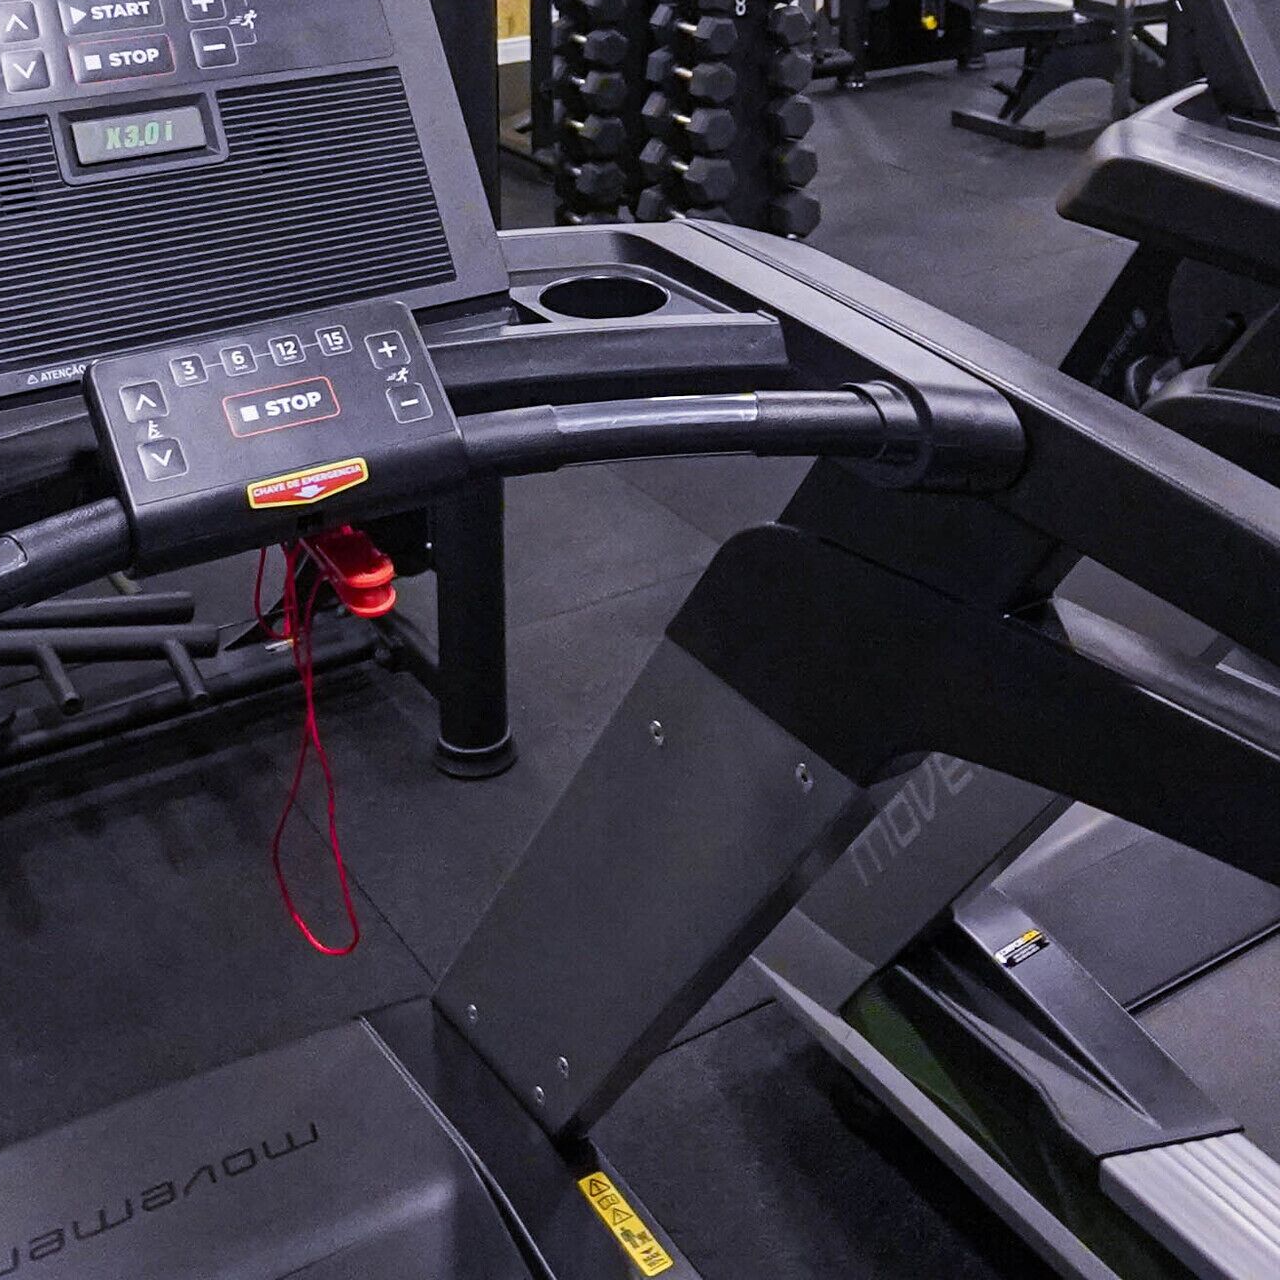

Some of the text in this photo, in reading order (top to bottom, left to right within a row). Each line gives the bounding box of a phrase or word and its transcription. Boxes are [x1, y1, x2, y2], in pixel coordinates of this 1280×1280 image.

[91, 0, 150, 20] START
[109, 48, 159, 67] STOP
[323, 332, 343, 347] 15
[276, 341, 297, 356] 12
[231, 351, 245, 365] 6
[181, 361, 195, 375] 3
[265, 391, 321, 416] STOP
[254, 482, 286, 497] CHAVE
[286, 479, 300, 490] DE
